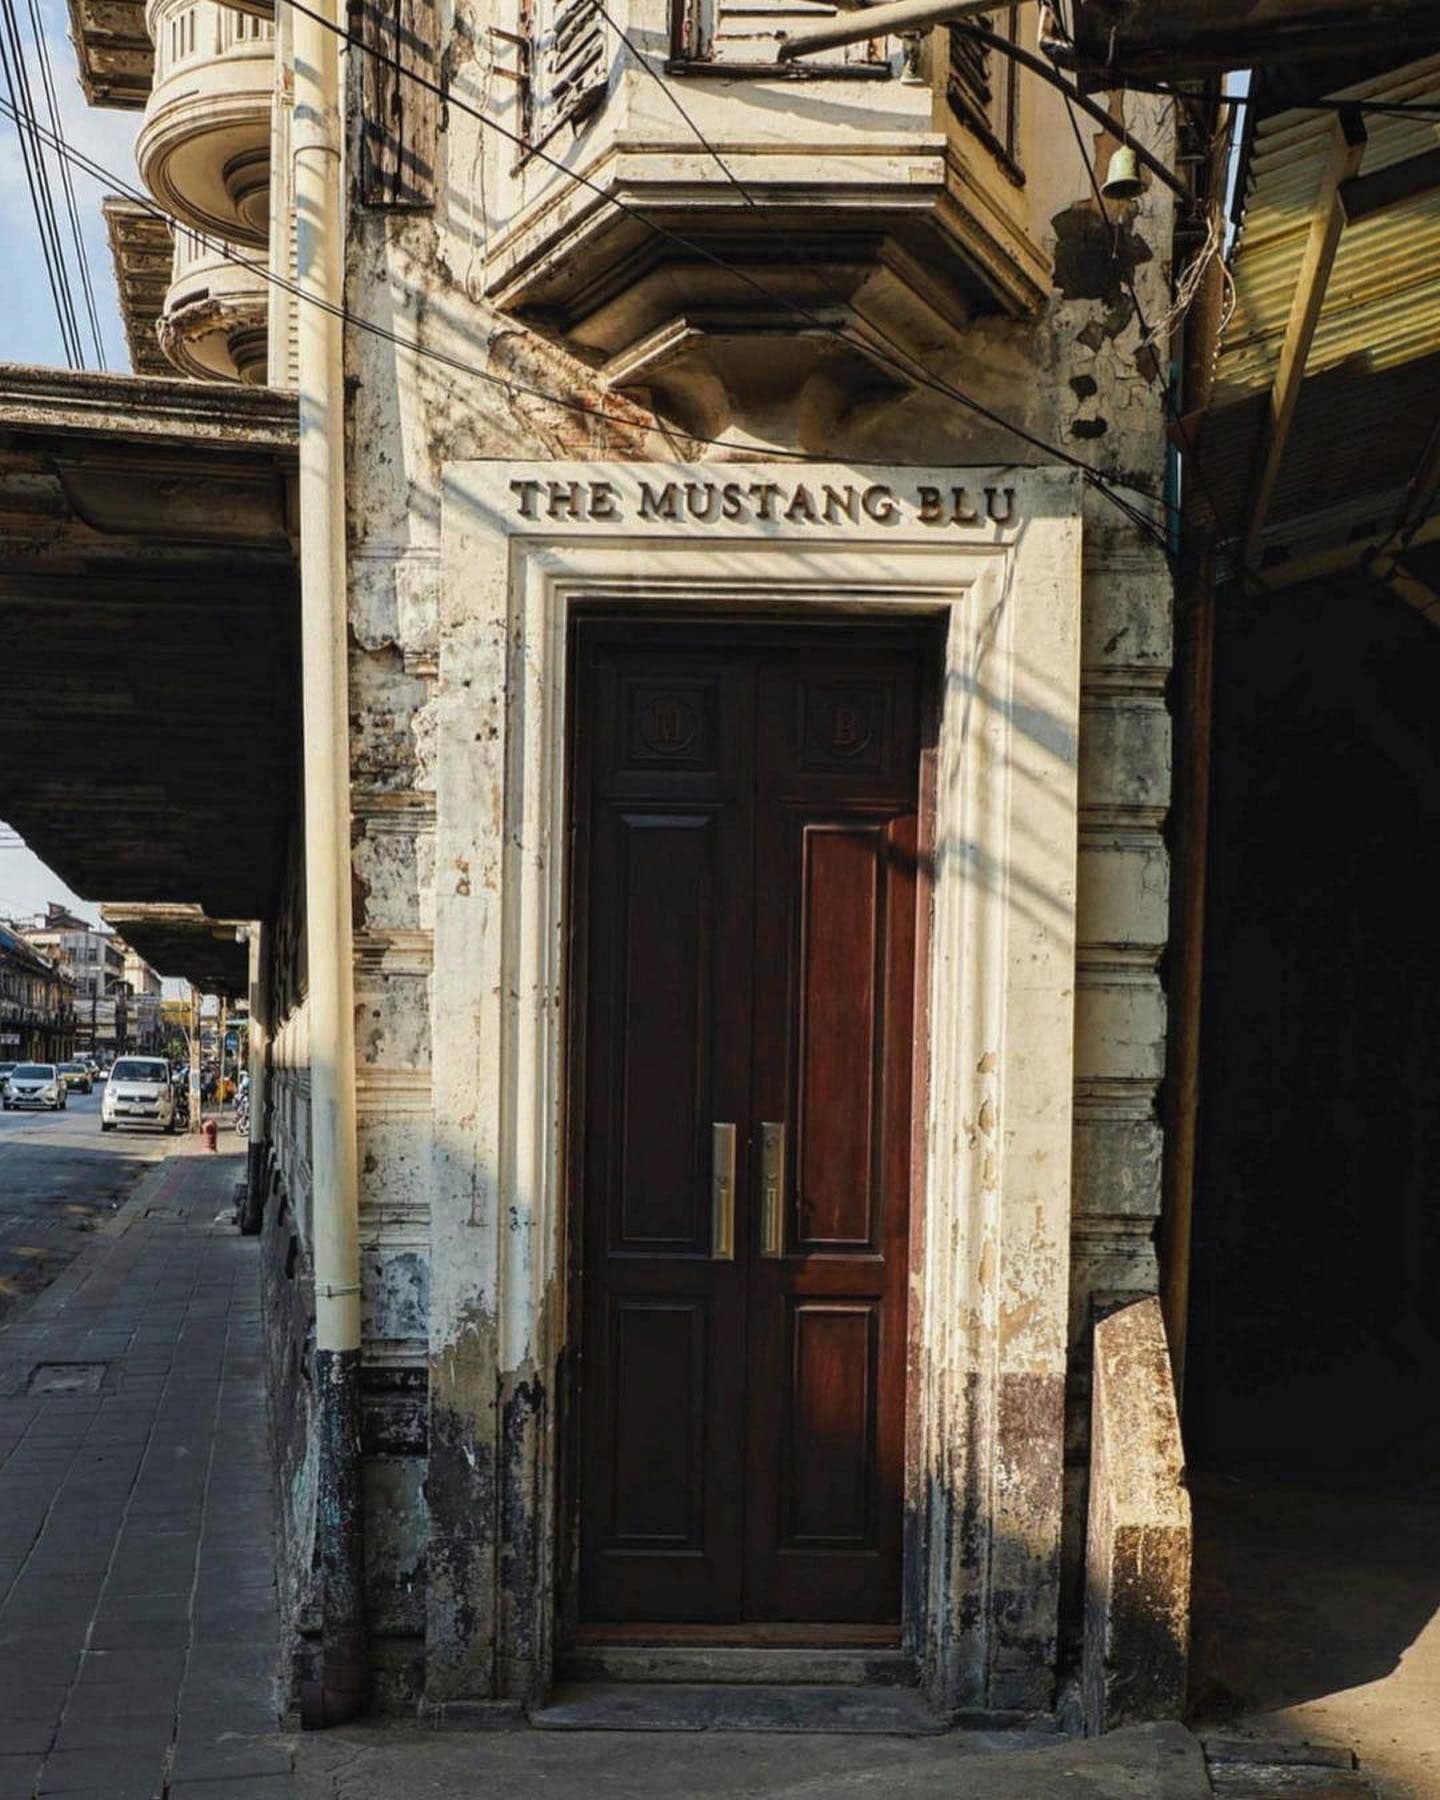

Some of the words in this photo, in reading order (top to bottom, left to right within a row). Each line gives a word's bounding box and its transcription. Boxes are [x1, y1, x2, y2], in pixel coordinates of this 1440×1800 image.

[509, 479, 616, 518] THE
[636, 481, 897, 522] MUSTANG
[916, 486, 1017, 523] BLU
[832, 704, 858, 744] B
